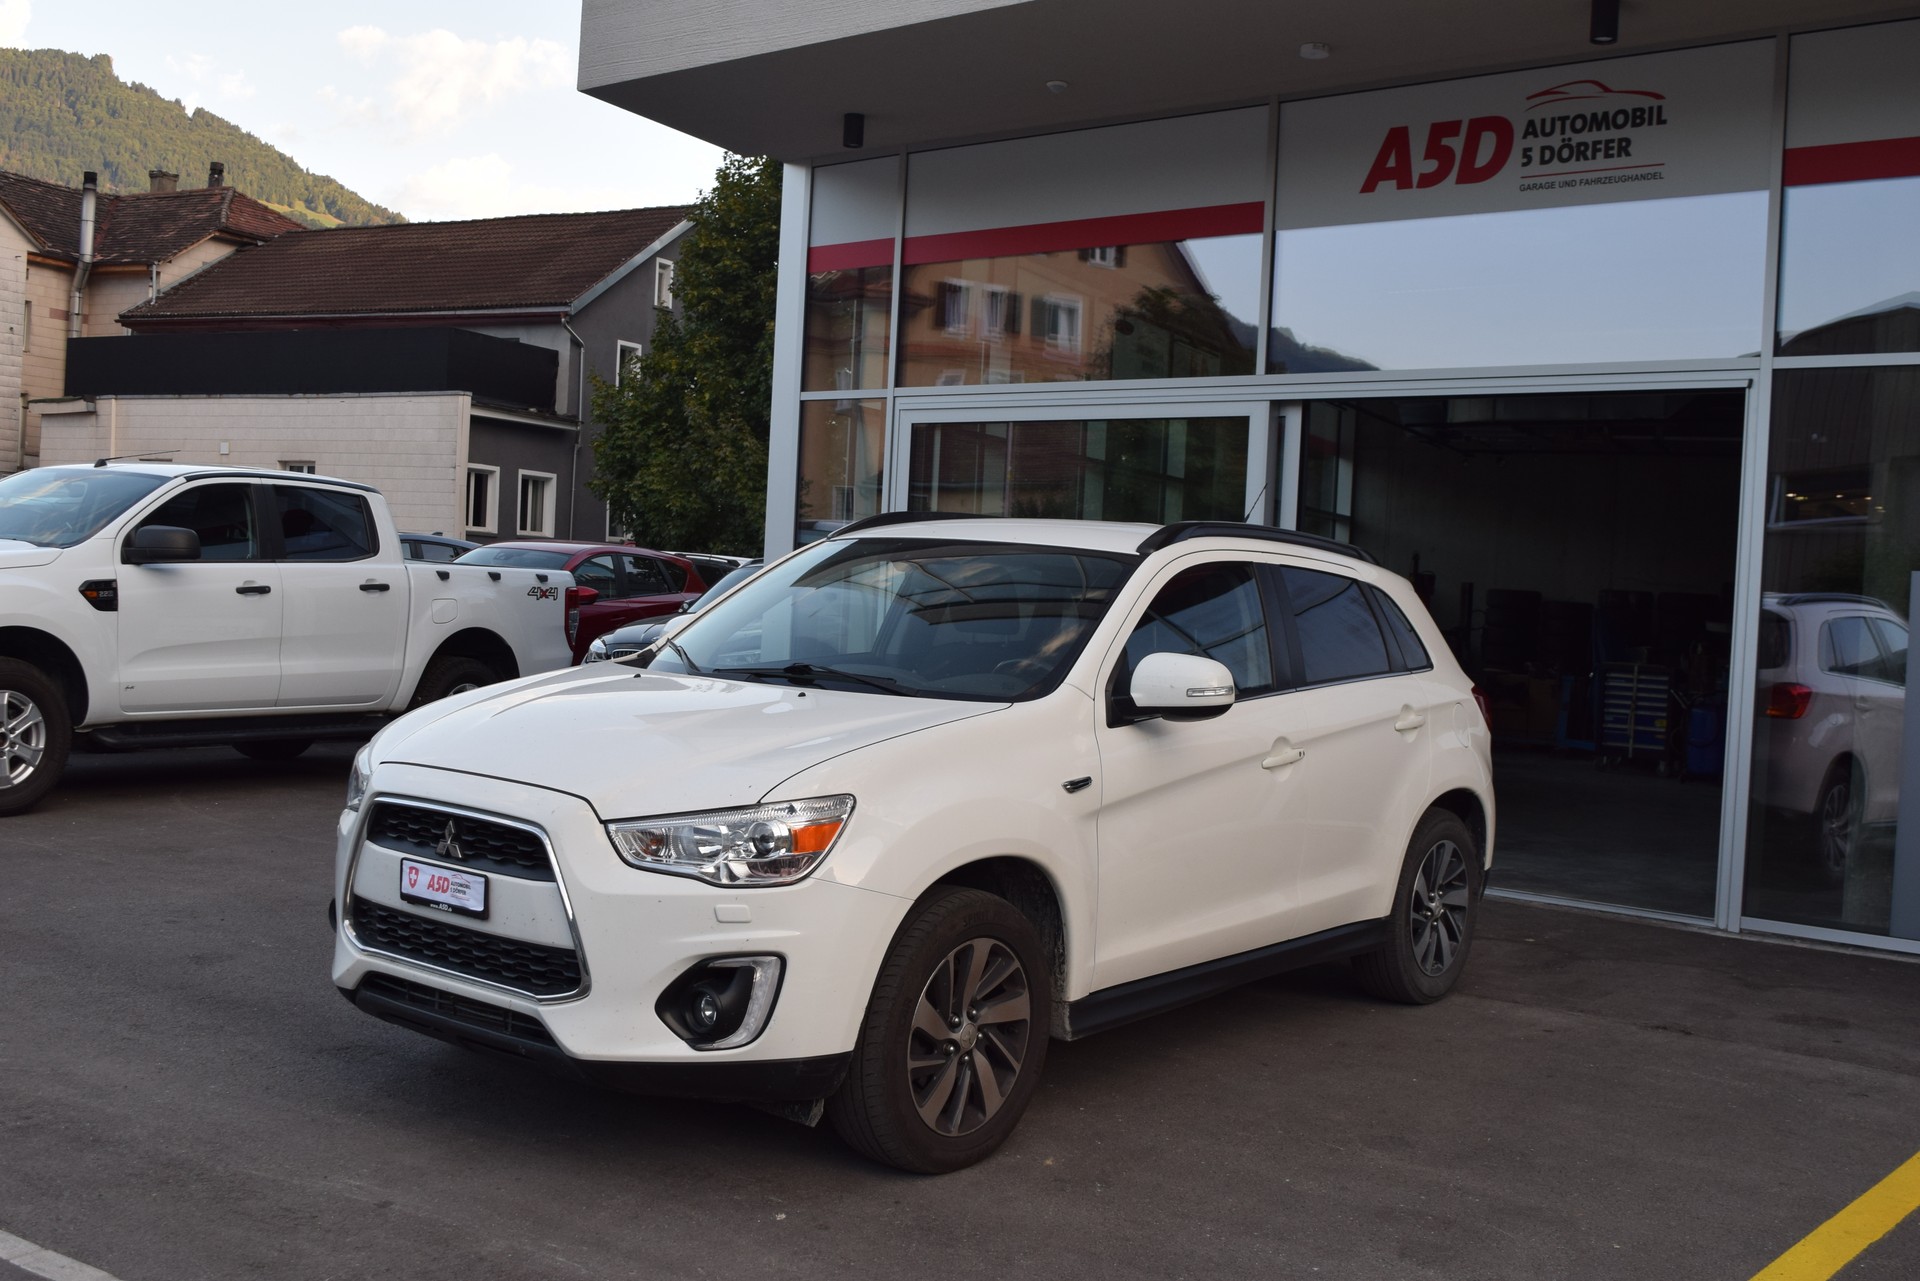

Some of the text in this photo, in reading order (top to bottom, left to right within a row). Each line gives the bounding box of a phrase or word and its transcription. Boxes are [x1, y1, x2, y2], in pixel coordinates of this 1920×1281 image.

[1522, 105, 1667, 139] AUTOMOBIL
[1359, 115, 1515, 193] A5D
[1521, 137, 1632, 167] 5 DÖRFER
[1519, 171, 1664, 192] GARAGE UND FAHRZEUGHANDEL
[427, 874, 450, 894] A5D
